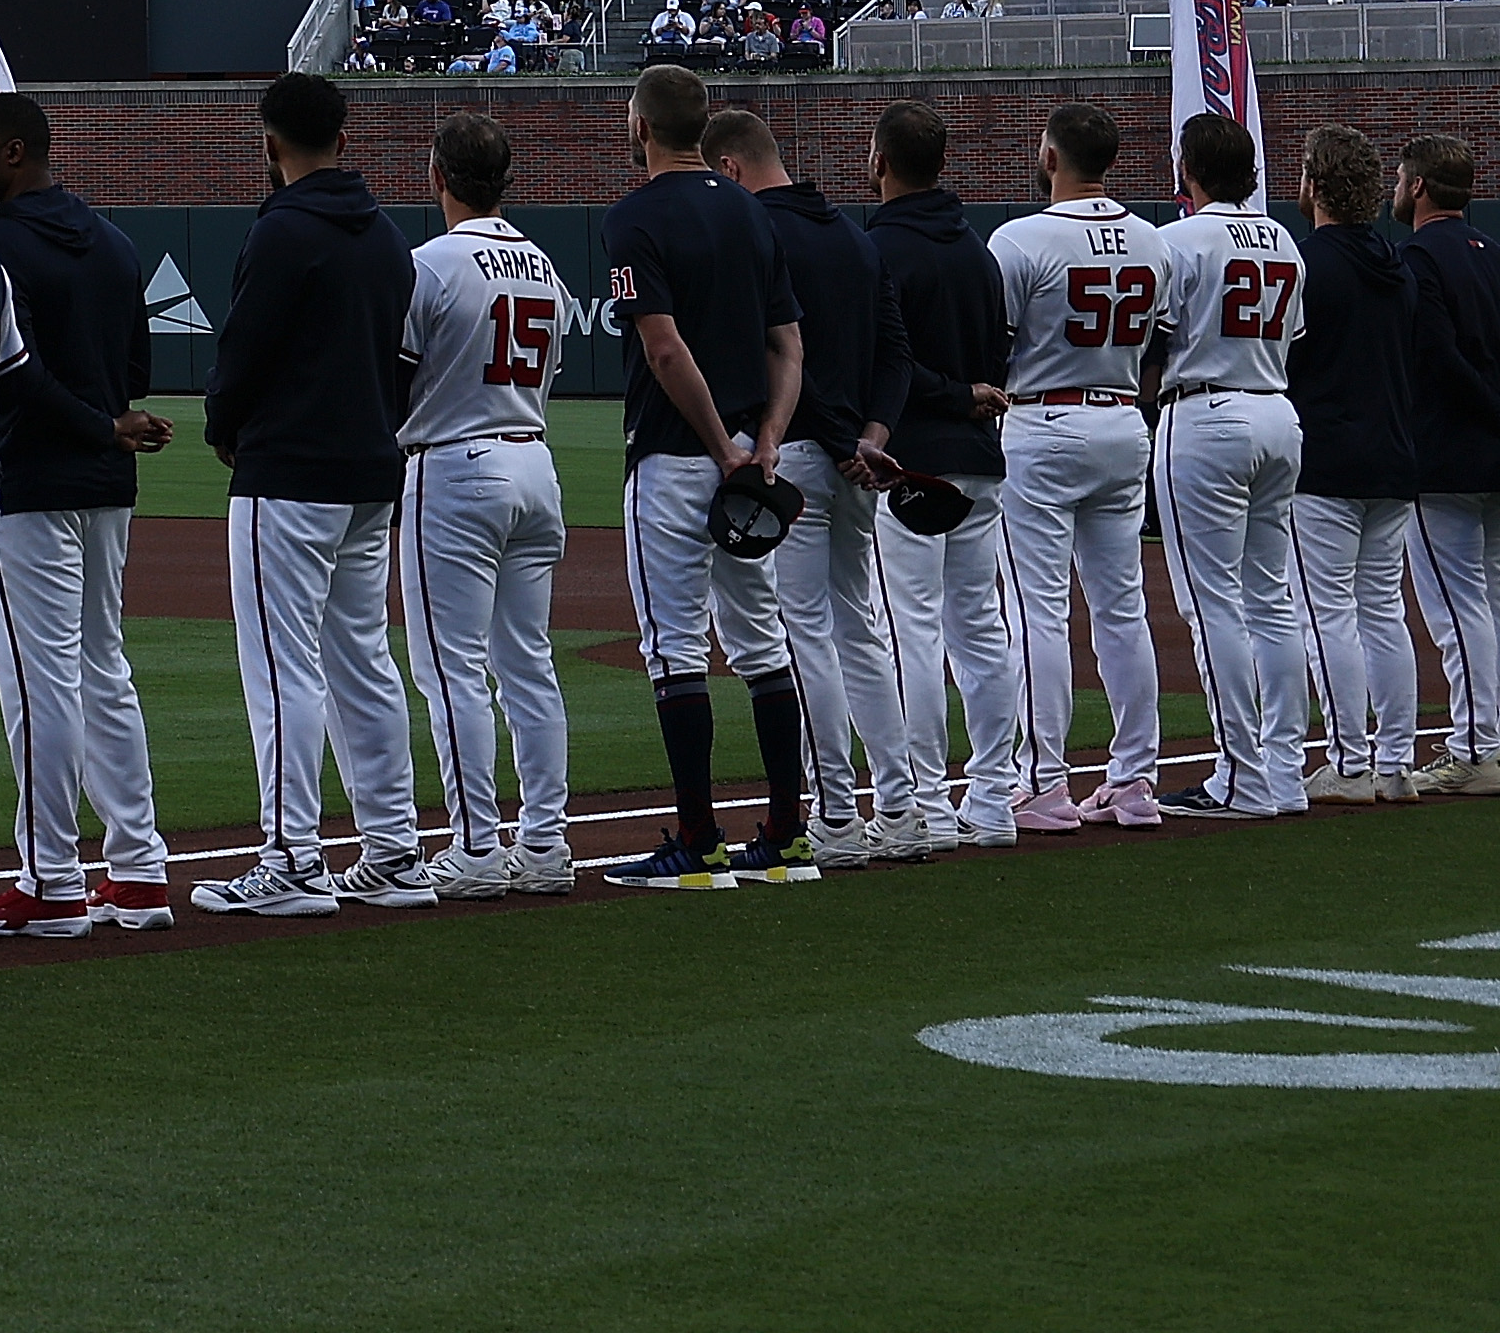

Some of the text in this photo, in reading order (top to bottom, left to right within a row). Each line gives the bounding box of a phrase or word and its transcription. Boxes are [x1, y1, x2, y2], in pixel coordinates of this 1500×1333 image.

[471, 247, 556, 287] FARMER
[1085, 227, 1128, 256] LEE
[1226, 221, 1280, 253] RILEY
[1063, 264, 1157, 348] 52
[1220, 257, 1298, 341] 27
[483, 292, 556, 389] 15
